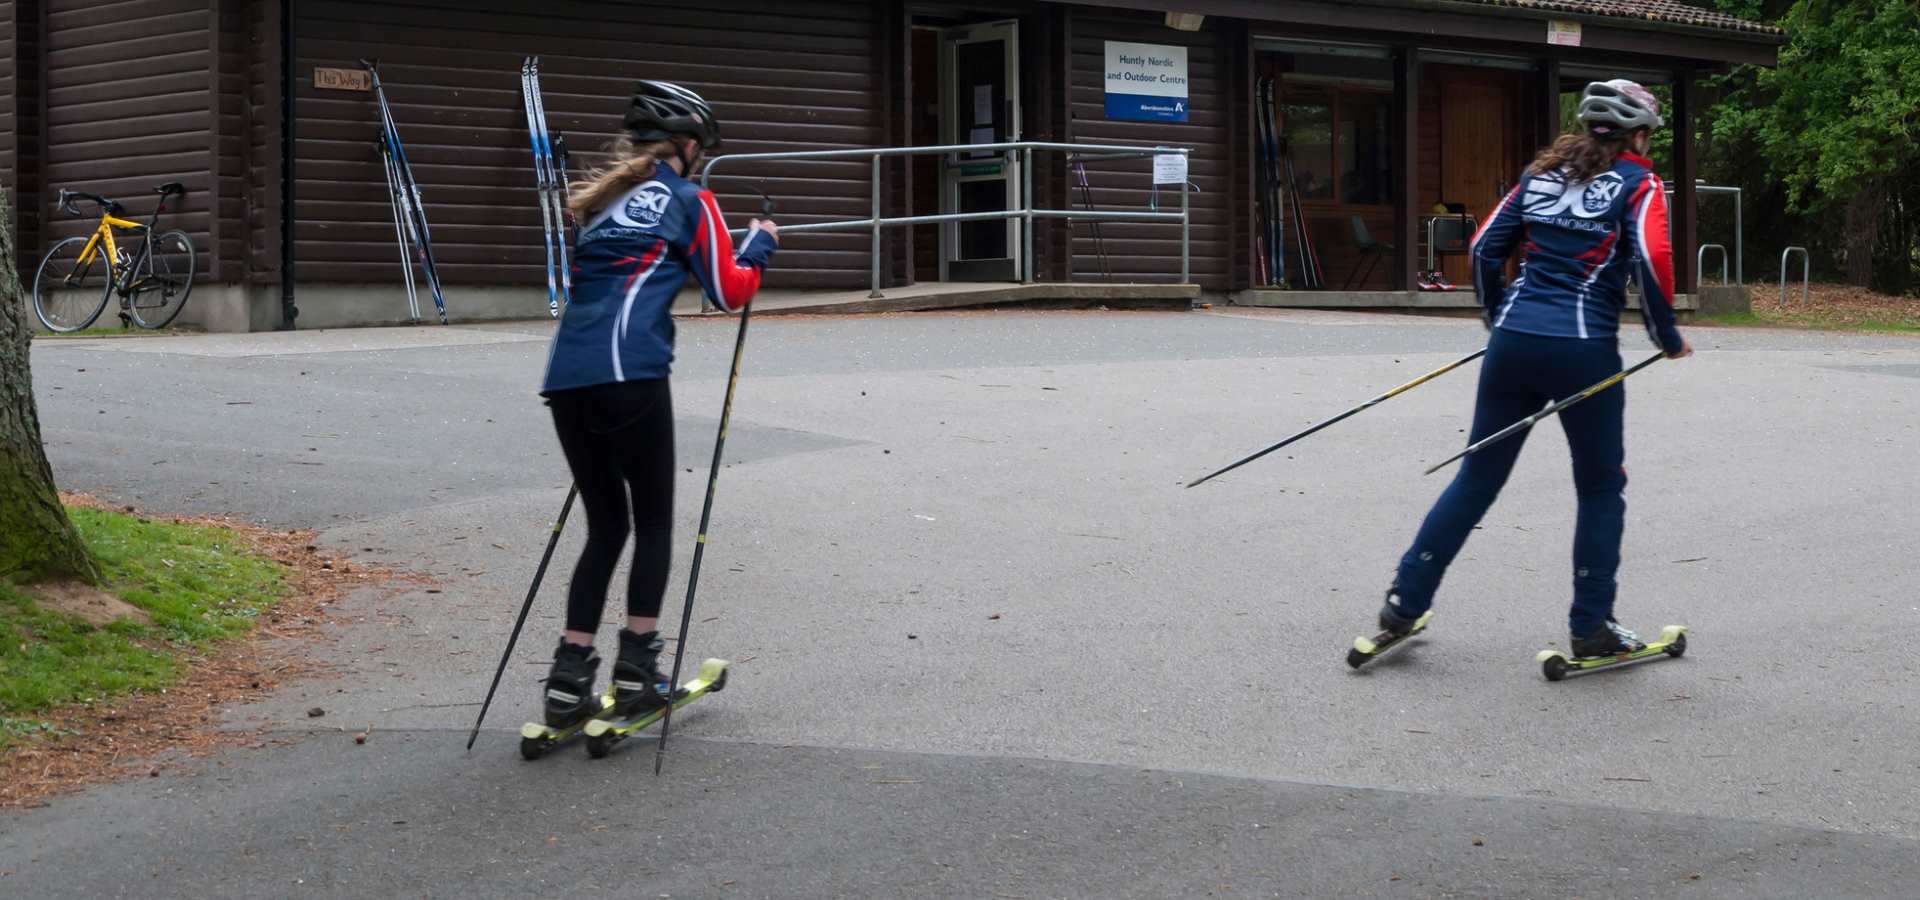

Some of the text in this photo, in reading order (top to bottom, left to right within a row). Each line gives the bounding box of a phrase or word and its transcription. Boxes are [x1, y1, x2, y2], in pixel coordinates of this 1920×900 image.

[1120, 55, 1174, 68] Huntly Nordic
[319, 70, 360, 89] This Way
[1107, 71, 1185, 85] and Outdoor Centre
[1584, 179, 1624, 201] SKI
[627, 190, 672, 215] SKI
[626, 206, 664, 224] TEAM
[1556, 216, 1614, 233] NORDIC
